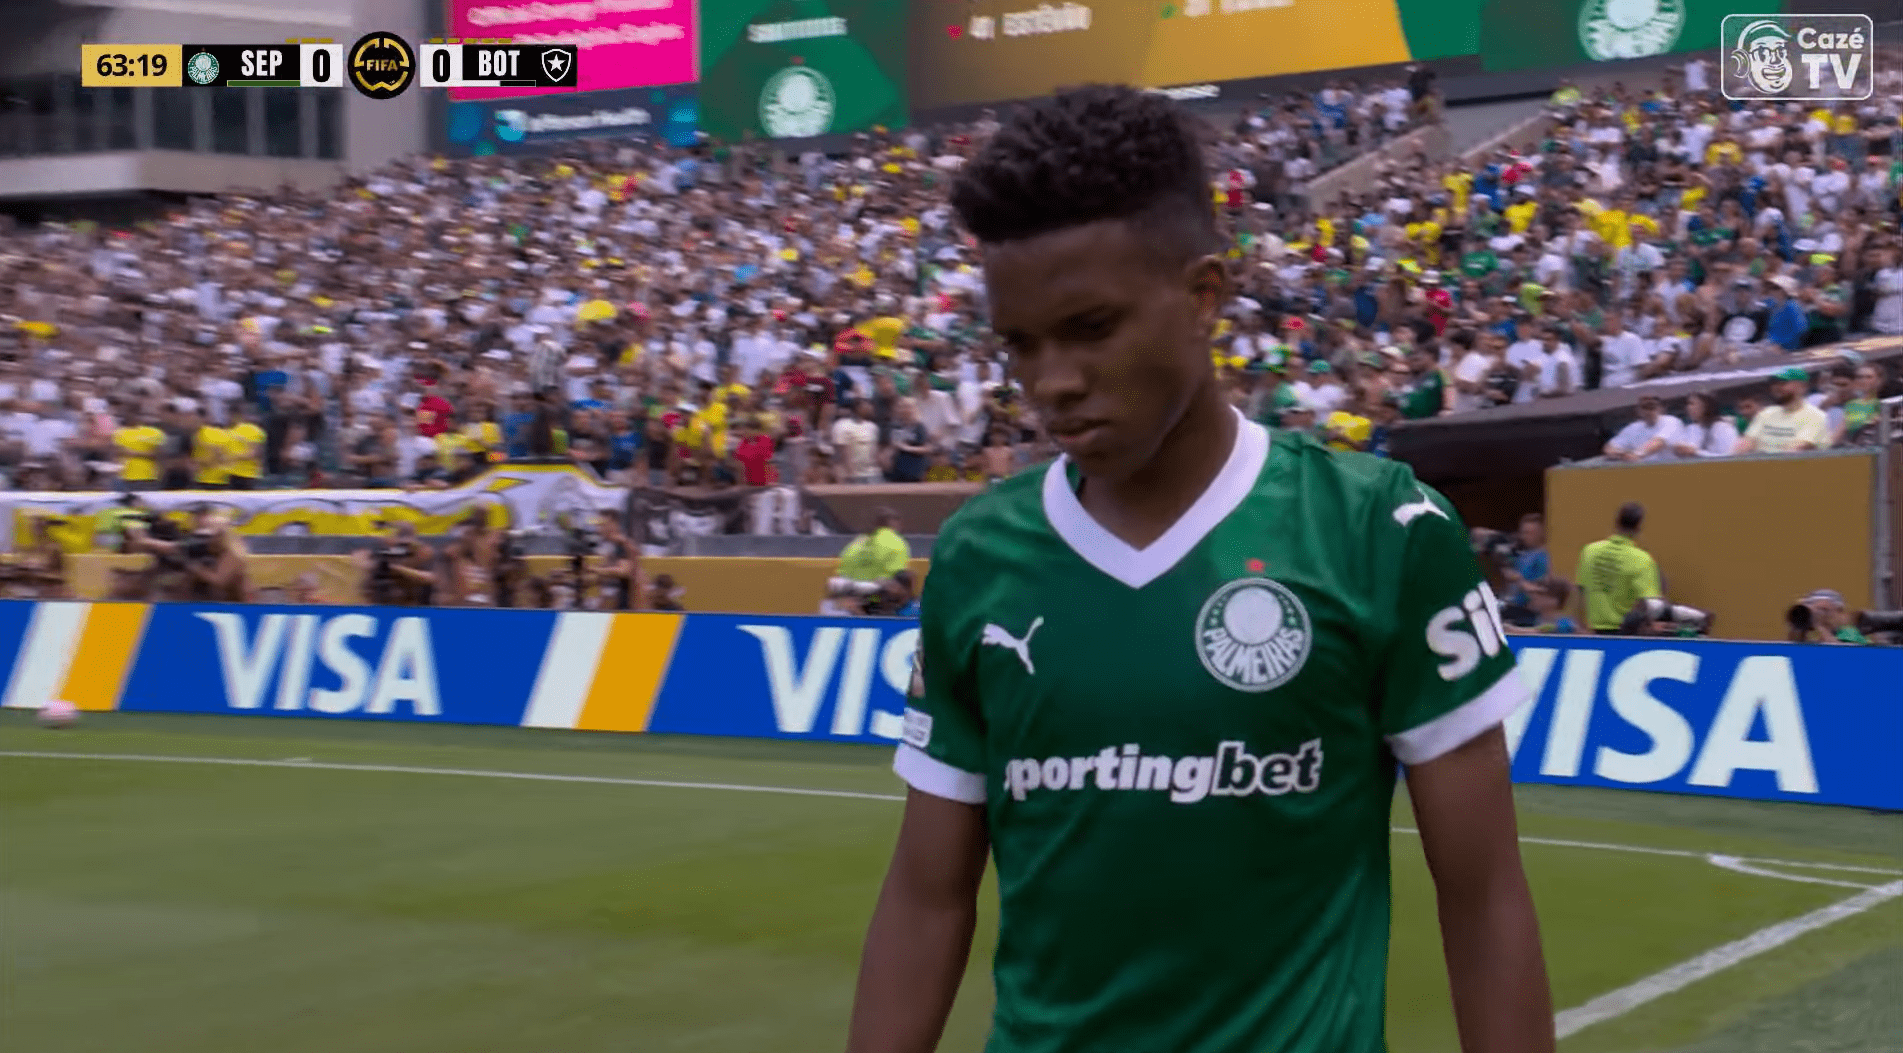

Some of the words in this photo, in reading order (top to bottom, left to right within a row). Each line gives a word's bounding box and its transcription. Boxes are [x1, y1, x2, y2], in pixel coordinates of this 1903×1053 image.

[194, 611, 442, 716] VISA
[735, 624, 922, 740] VI
[1202, 627, 1304, 684] PALMEIRAS
